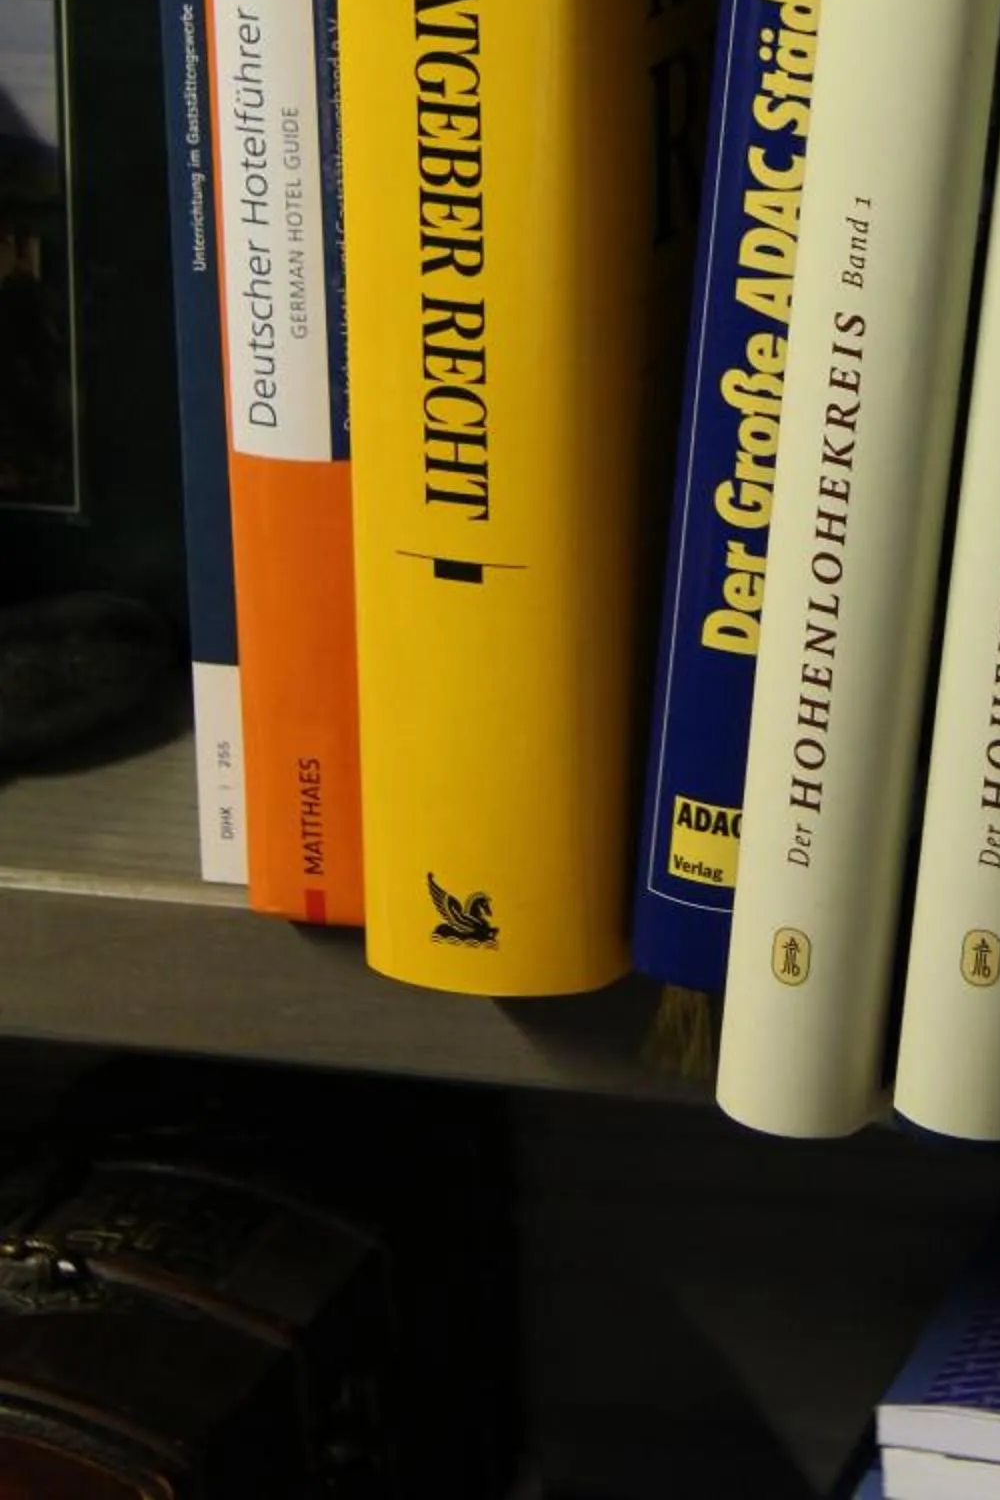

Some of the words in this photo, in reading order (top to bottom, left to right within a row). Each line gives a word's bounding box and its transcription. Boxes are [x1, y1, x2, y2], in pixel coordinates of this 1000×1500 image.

[180, 3, 200, 144] Gaststättengewerbe
[234, 6, 269, 227] Hotelführer
[187, 149, 201, 168] im
[281, 106, 300, 171] GUIDE
[189, 173, 206, 272] Unterrichtung
[285, 177, 304, 242] HOTEL
[735, 145, 806, 325] ADAC
[841, 217, 869, 289] Band
[855, 197, 872, 208] 1
[243, 240, 277, 428] Deutscher
[289, 249, 308, 339] GERMAN
[421, 294, 488, 520] RECHT
[715, 332, 788, 529] Große
[702, 543, 767, 656] Der
[790, 312, 867, 812] HOHENLOHEKREIS
[299, 756, 325, 876] MATTHAES
[674, 855, 723, 882] Verlag
[788, 824, 812, 868] Der
